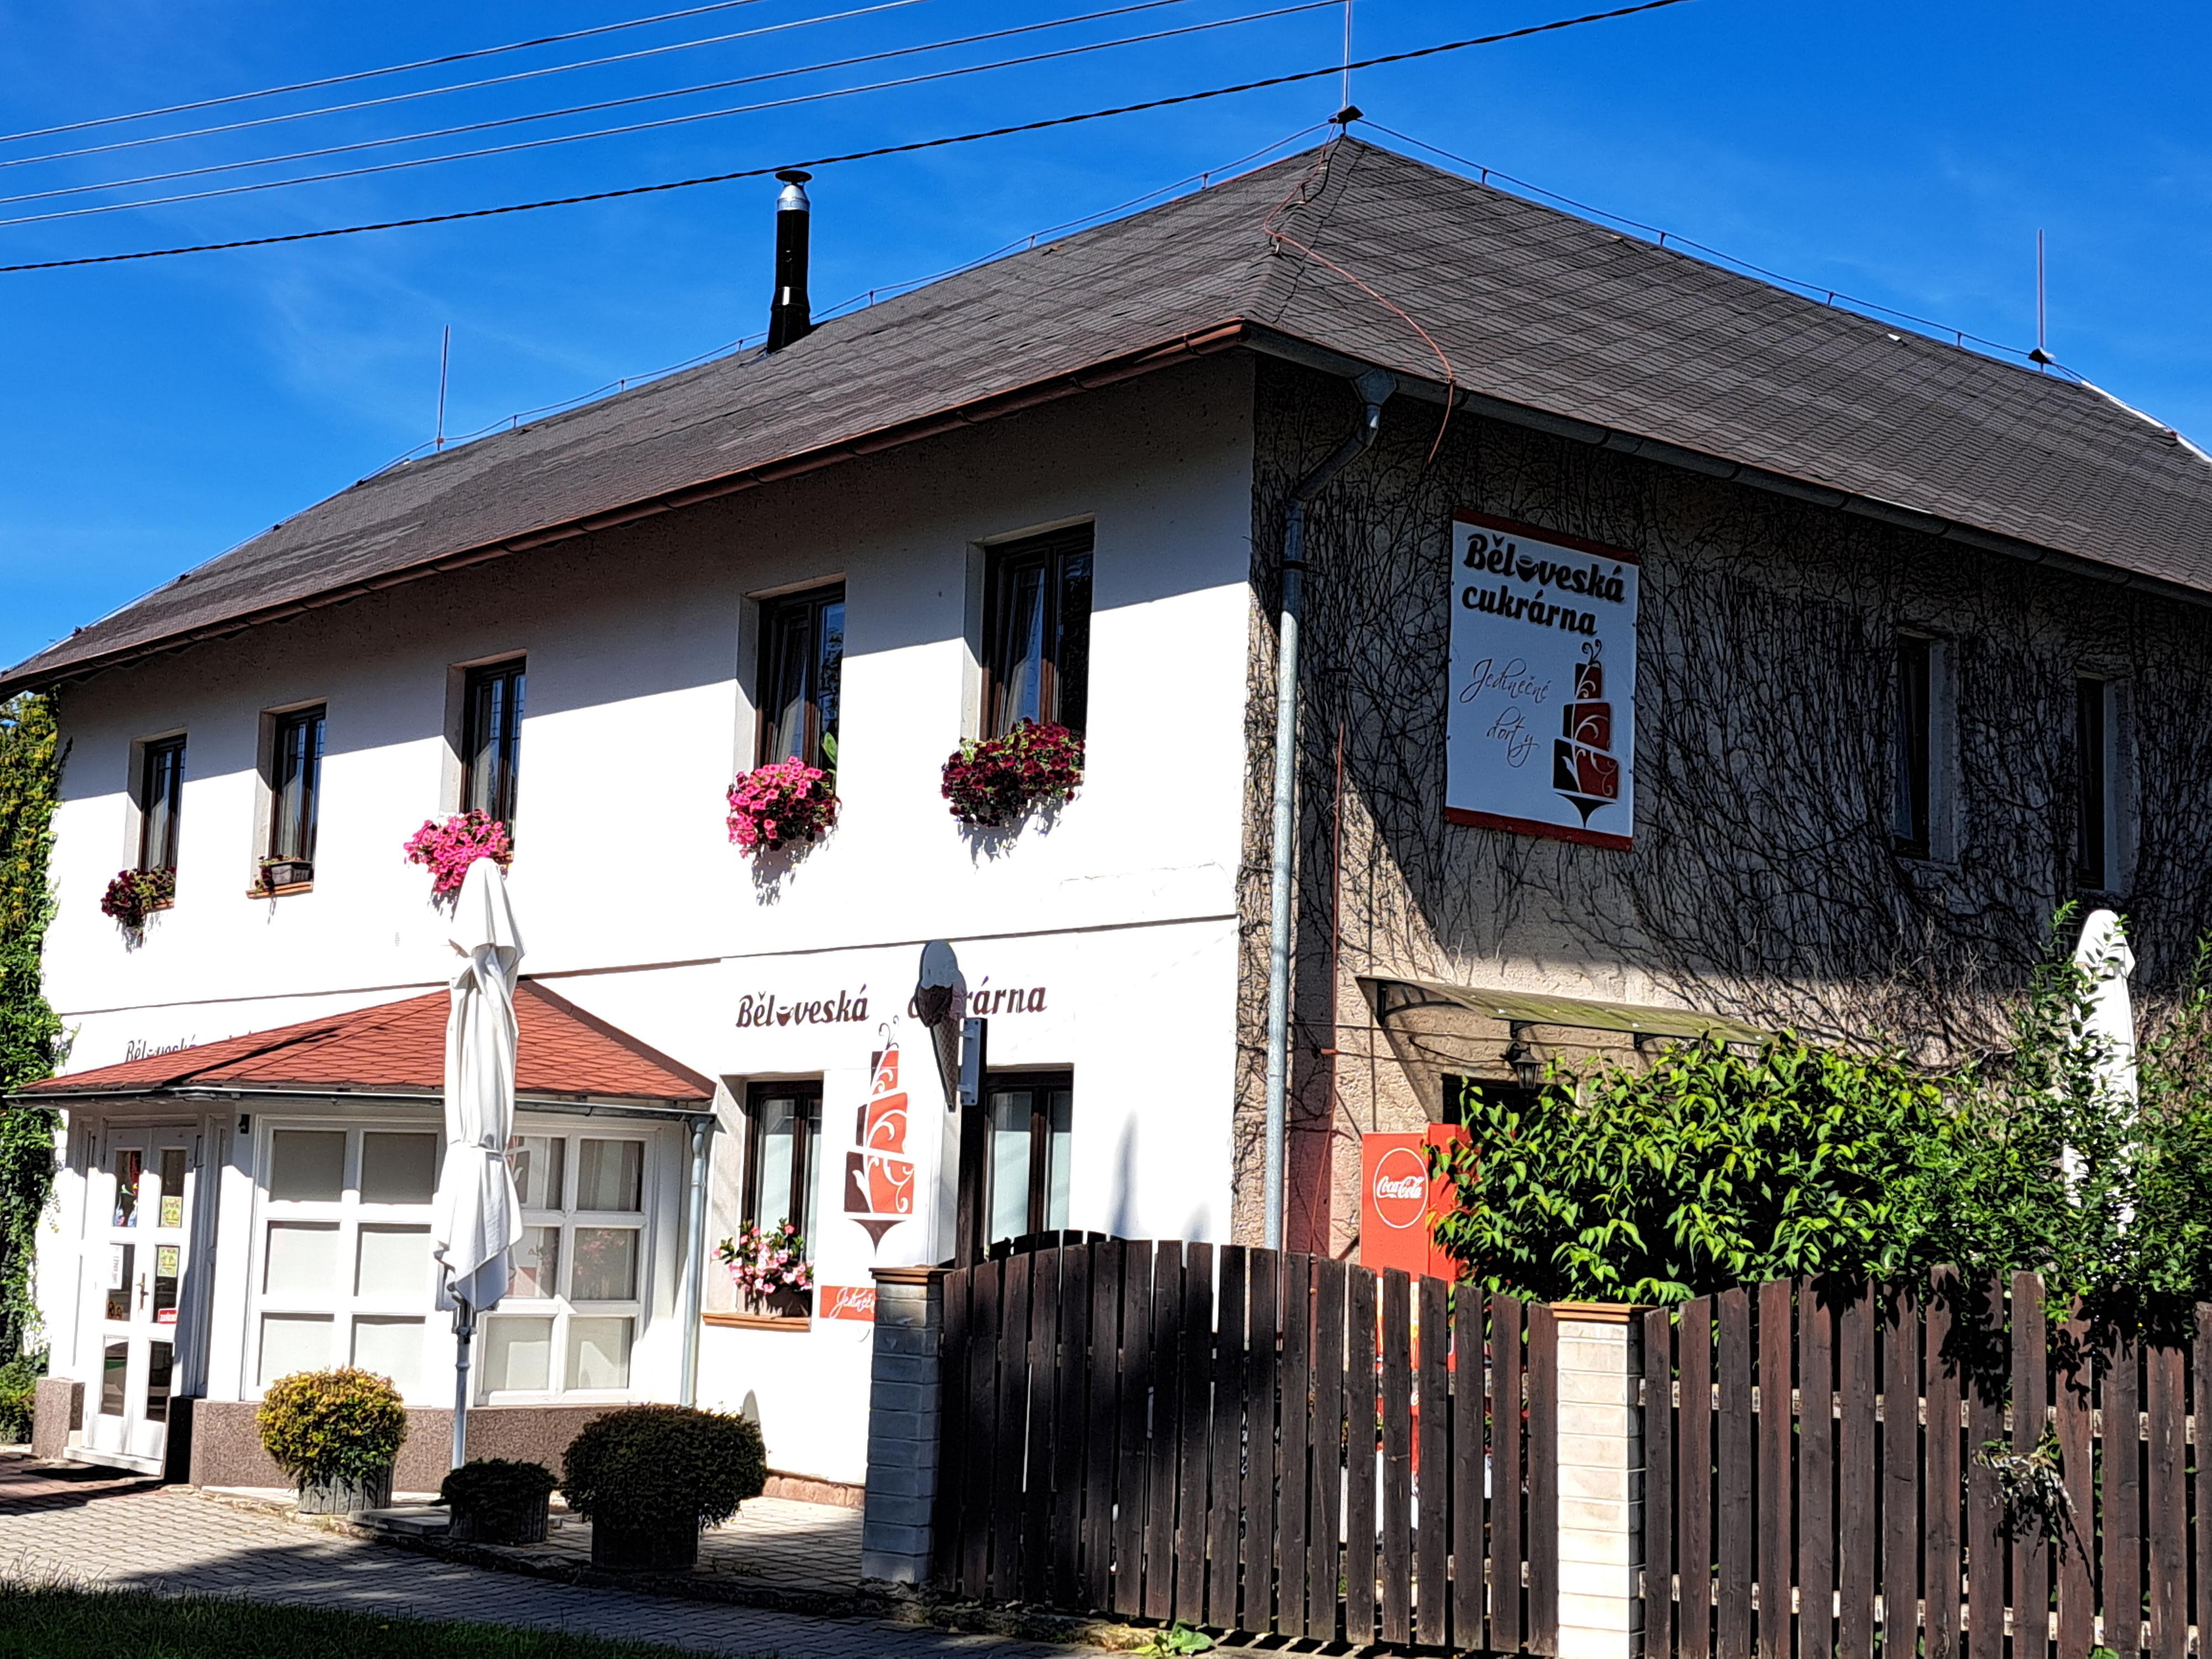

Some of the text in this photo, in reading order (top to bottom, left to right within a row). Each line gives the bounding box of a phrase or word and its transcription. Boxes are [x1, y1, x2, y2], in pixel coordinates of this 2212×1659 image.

[1462, 585, 1598, 636] cukrárna
[1459, 658, 1552, 703] Jedinečné
[1486, 706, 1541, 768] dorty
[1376, 1176, 1425, 1199] Coca-Cola
